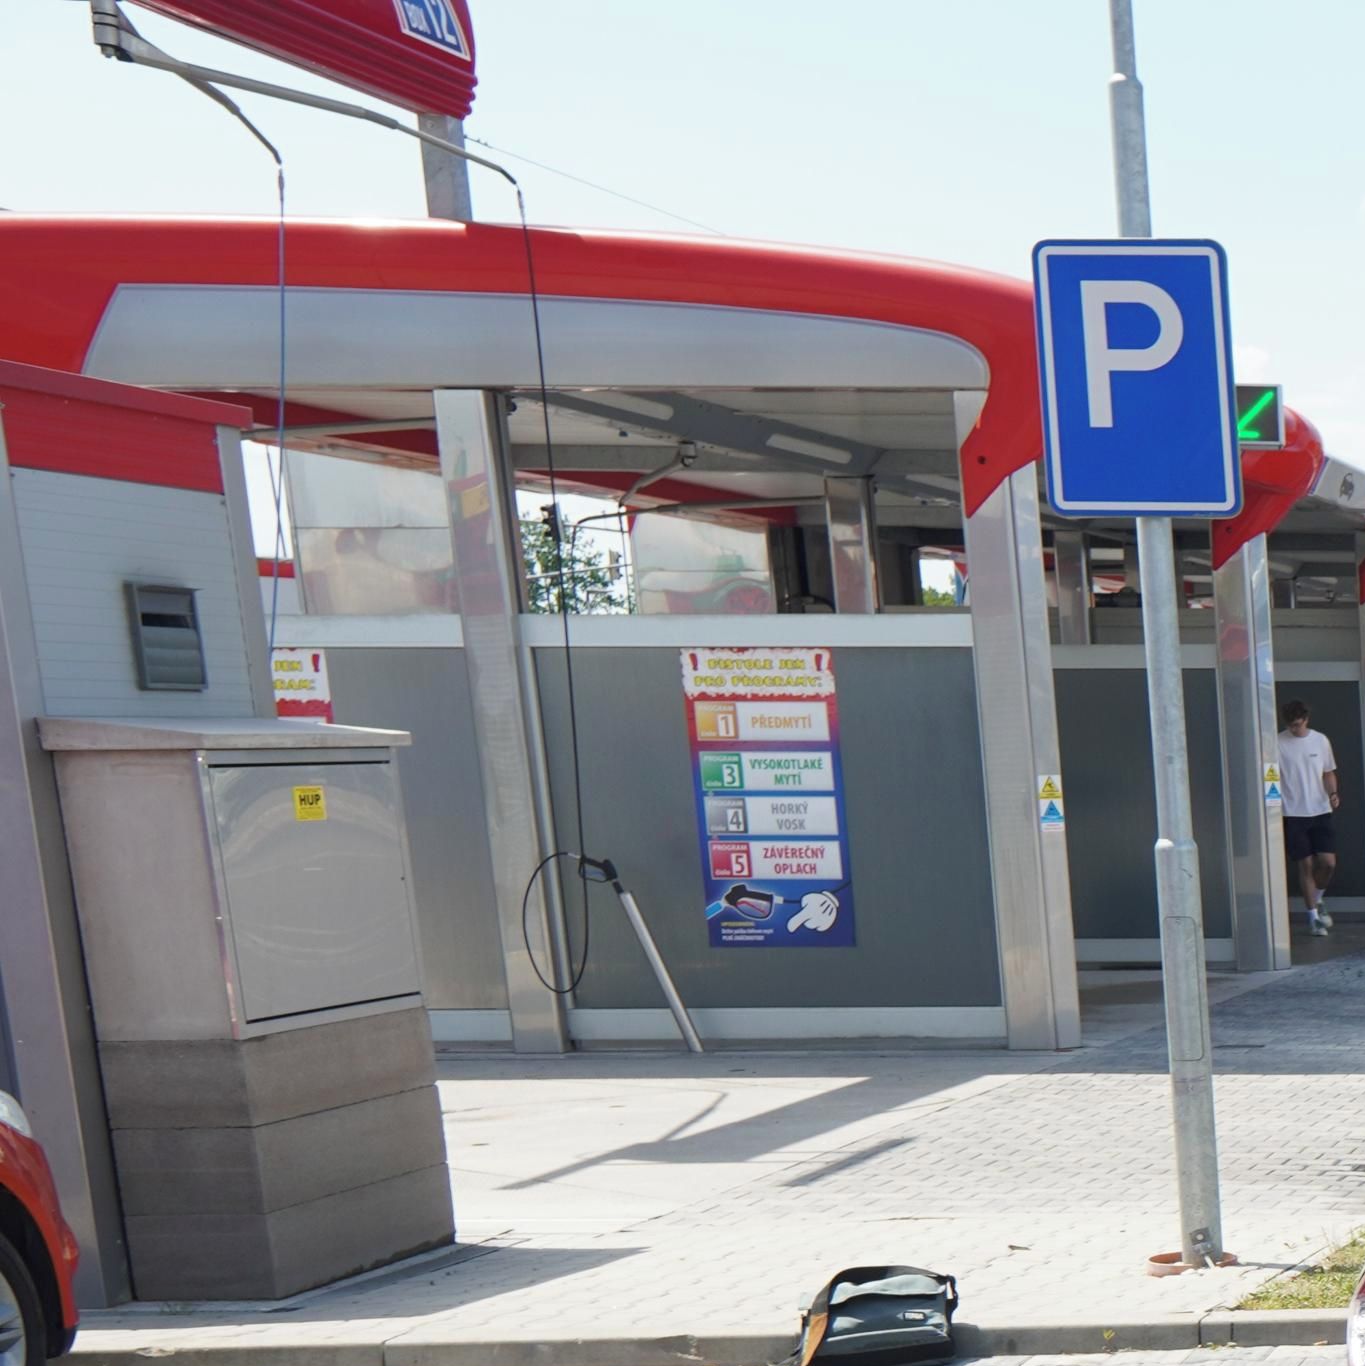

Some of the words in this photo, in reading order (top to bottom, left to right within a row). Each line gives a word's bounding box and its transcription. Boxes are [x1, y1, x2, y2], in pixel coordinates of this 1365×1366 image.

[423, 0, 457, 45] 12
[1080, 280, 1184, 428] P
[707, 658, 773, 670] PISTOLE
[779, 658, 806, 670] JEN
[694, 675, 726, 687] PRO
[720, 715, 731, 735] 1
[751, 713, 812, 729] PŘEDMYTÍ
[749, 756, 824, 770] VYSOKOTLAKÉ
[725, 765, 736, 785] 3
[774, 772, 802, 785] MYTÍ
[299, 794, 320, 806] HUP
[771, 802, 809, 815] HORKÝ
[729, 811, 742, 830] 4
[776, 819, 806, 830] VOSK
[763, 844, 826, 859] ZÁVĚREČNÝ
[735, 855, 745, 874] 5
[774, 863, 817, 875] OPLACH
